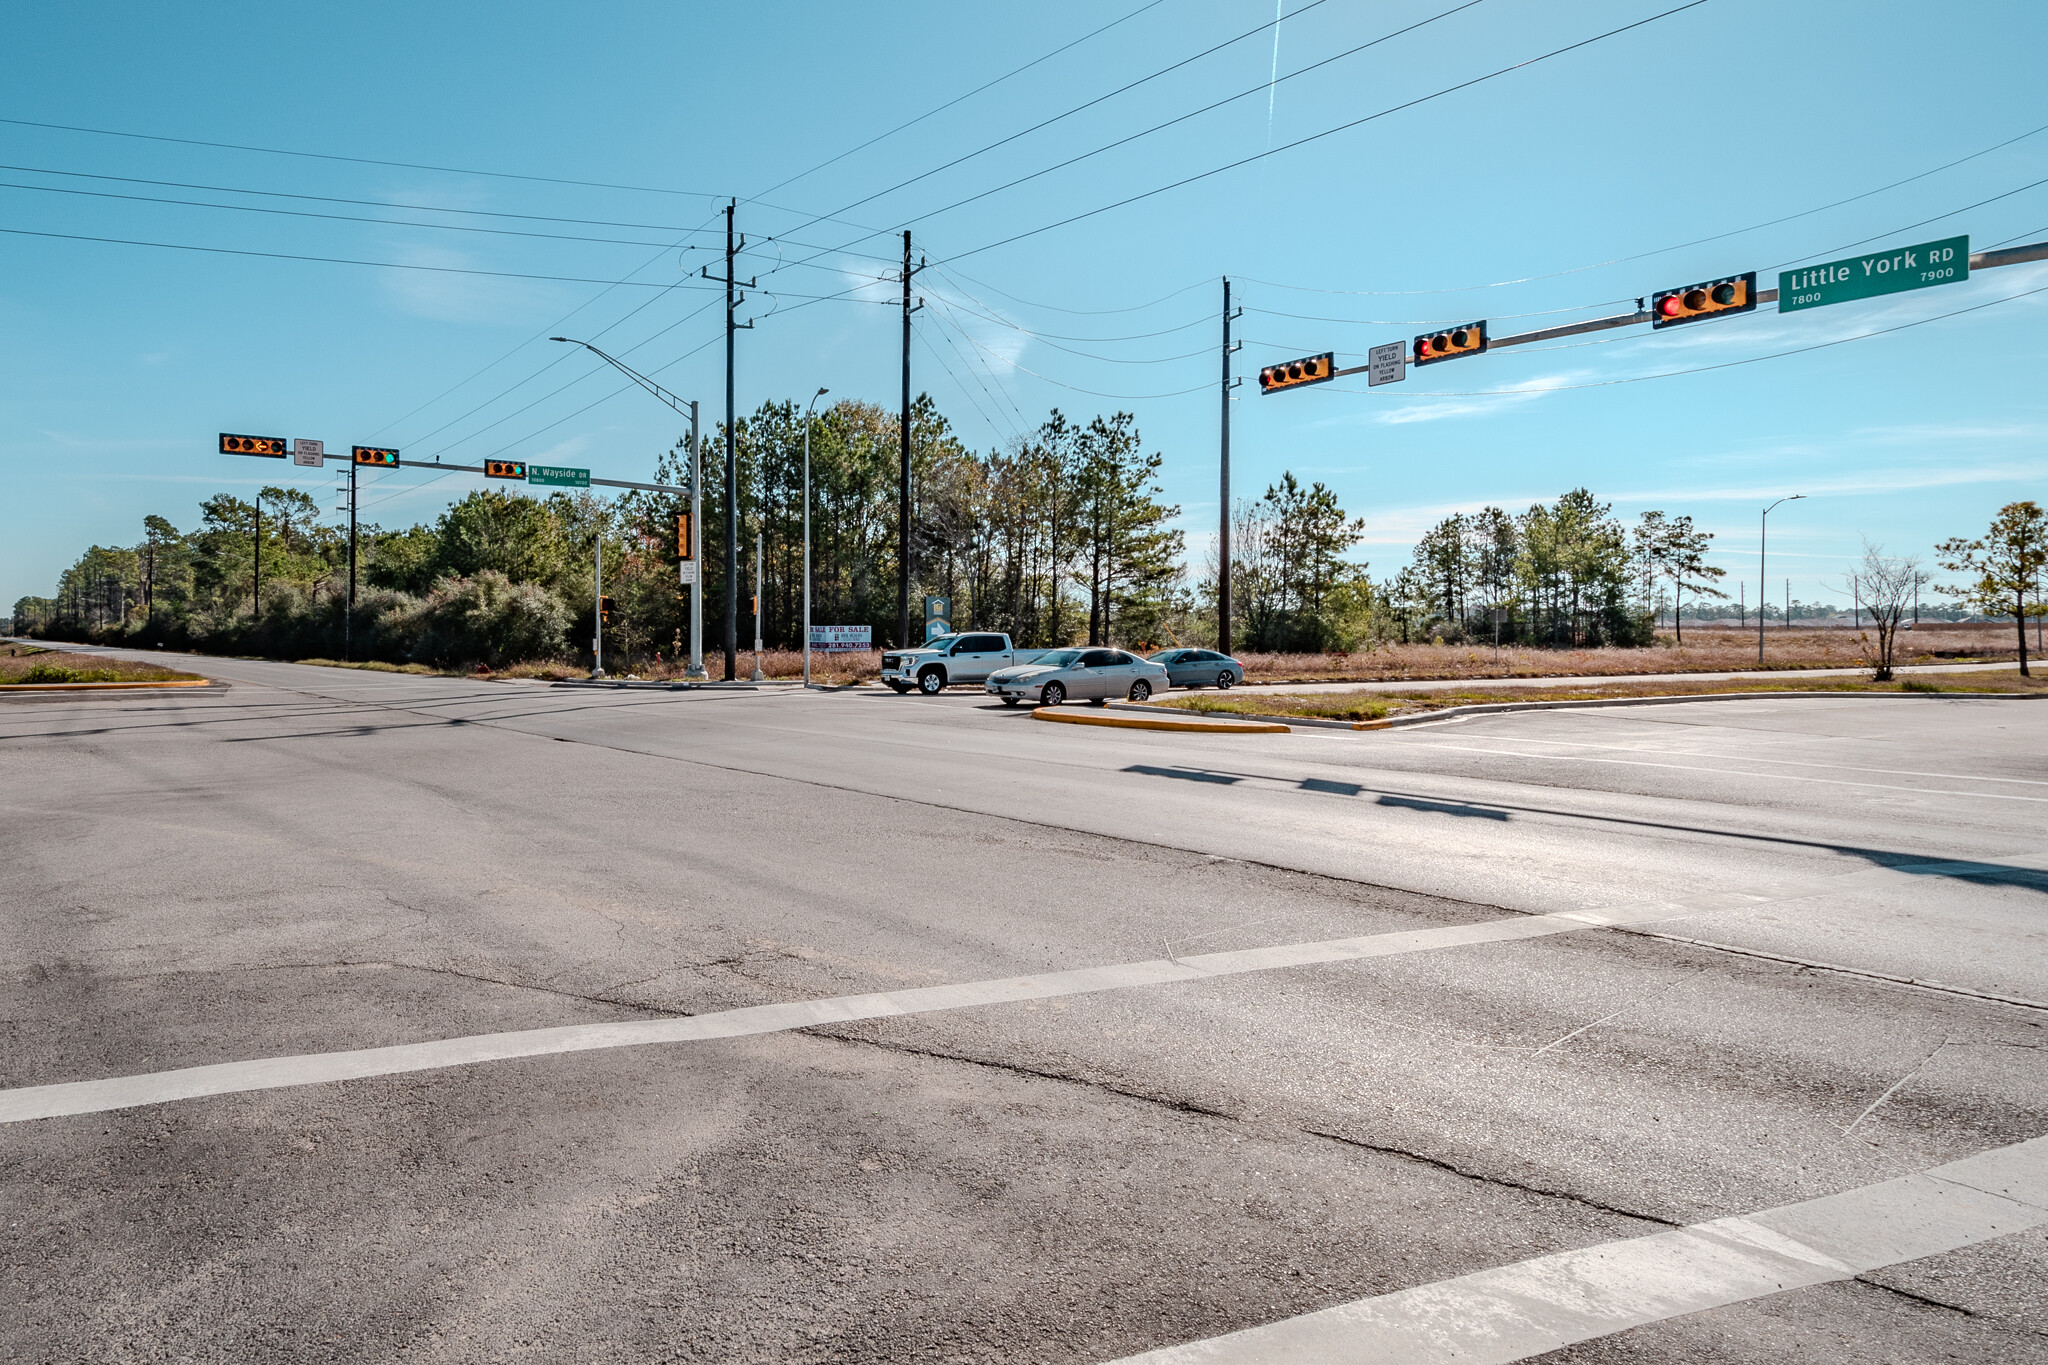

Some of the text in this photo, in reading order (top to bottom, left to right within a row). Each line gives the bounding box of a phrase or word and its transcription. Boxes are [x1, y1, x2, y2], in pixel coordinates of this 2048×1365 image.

[1792, 248, 1954, 290] Little York RD
[1920, 268, 1954, 282] 7900
[1792, 292, 1821, 305] 7800
[1378, 352, 1396, 362] YIELD
[531, 467, 540, 476] N.
[542, 468, 576, 478] Wayside
